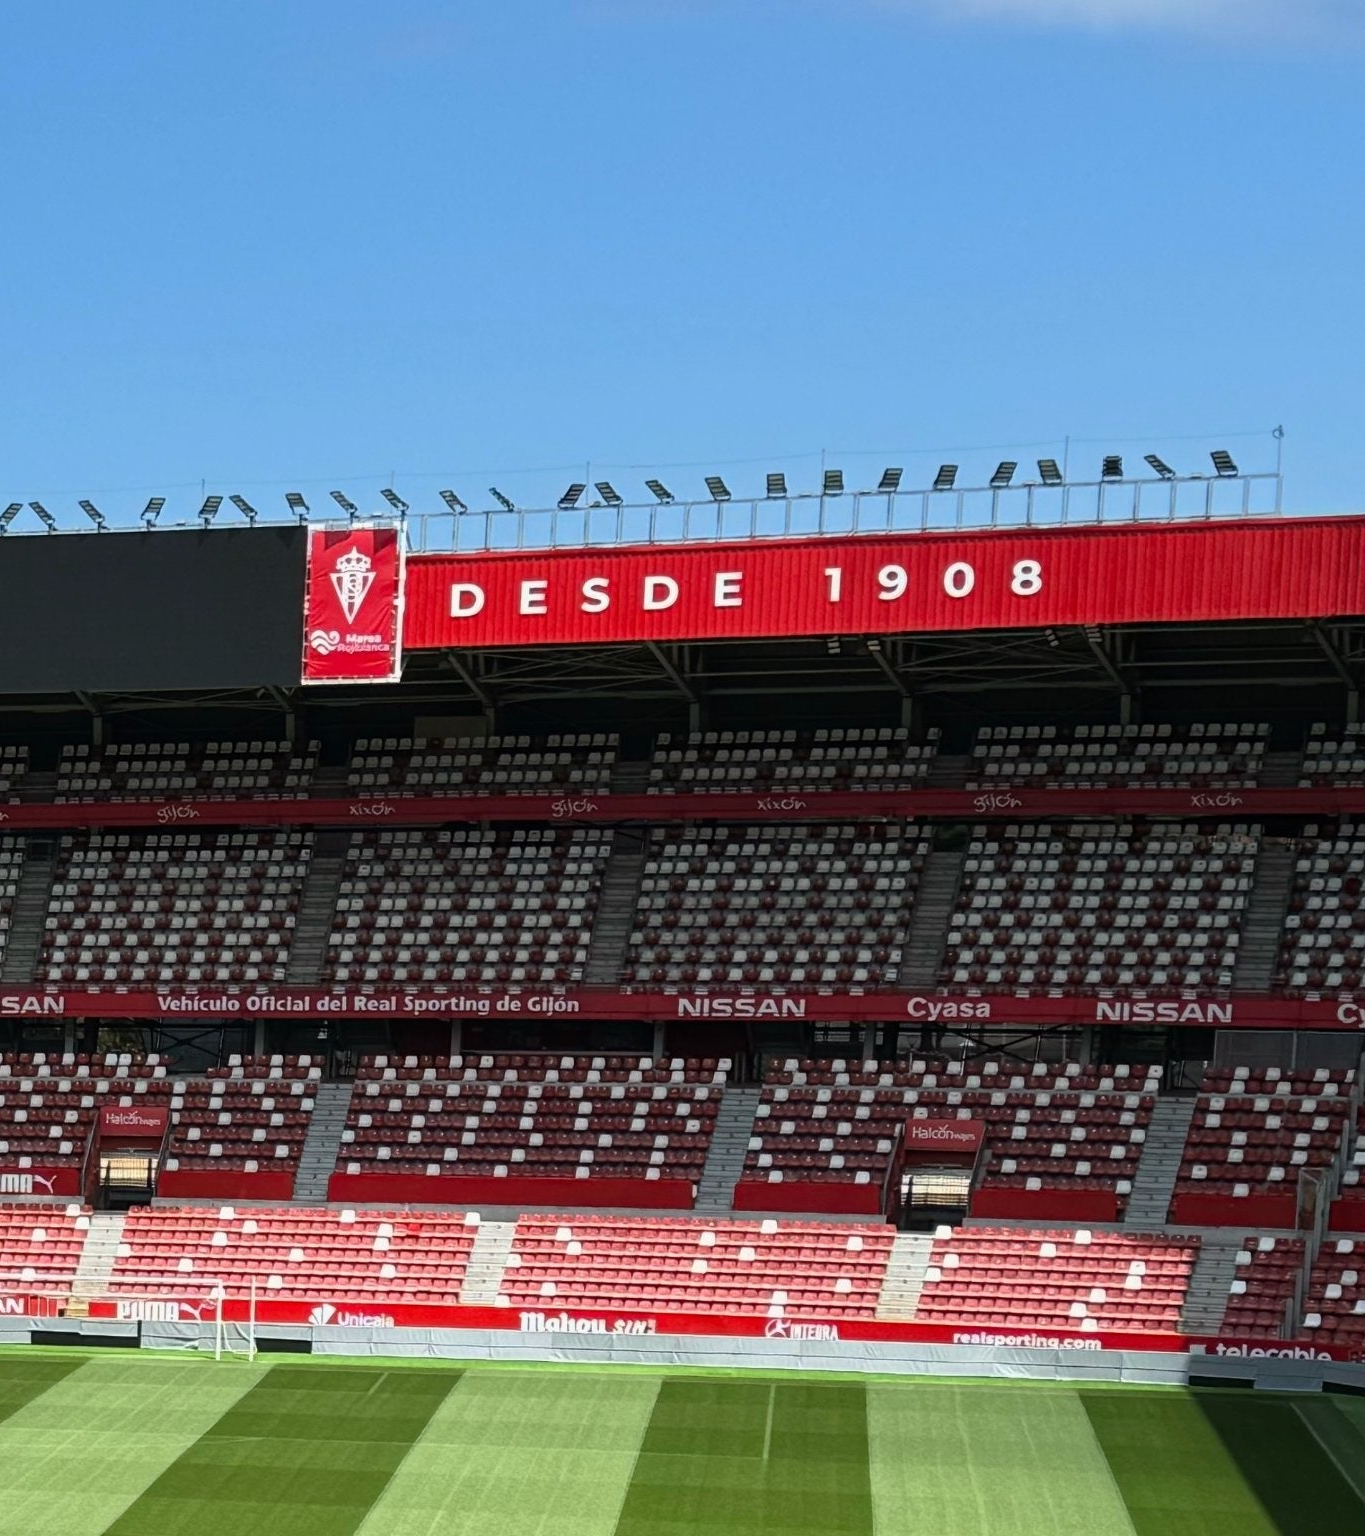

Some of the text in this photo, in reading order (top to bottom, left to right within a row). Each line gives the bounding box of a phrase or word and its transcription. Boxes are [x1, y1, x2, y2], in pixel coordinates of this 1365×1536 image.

[450, 559, 1044, 618] DESDE 1908
[157, 995, 580, 1017] Vehículo Oficial del Real Sporting de Gijón
[678, 998, 806, 1017] NISSAN
[907, 997, 991, 1021] Cyasa
[1096, 1001, 1233, 1023] NISSAN
[912, 1124, 954, 1139] Halcón
[953, 1332, 1102, 1350] realsporting.com
